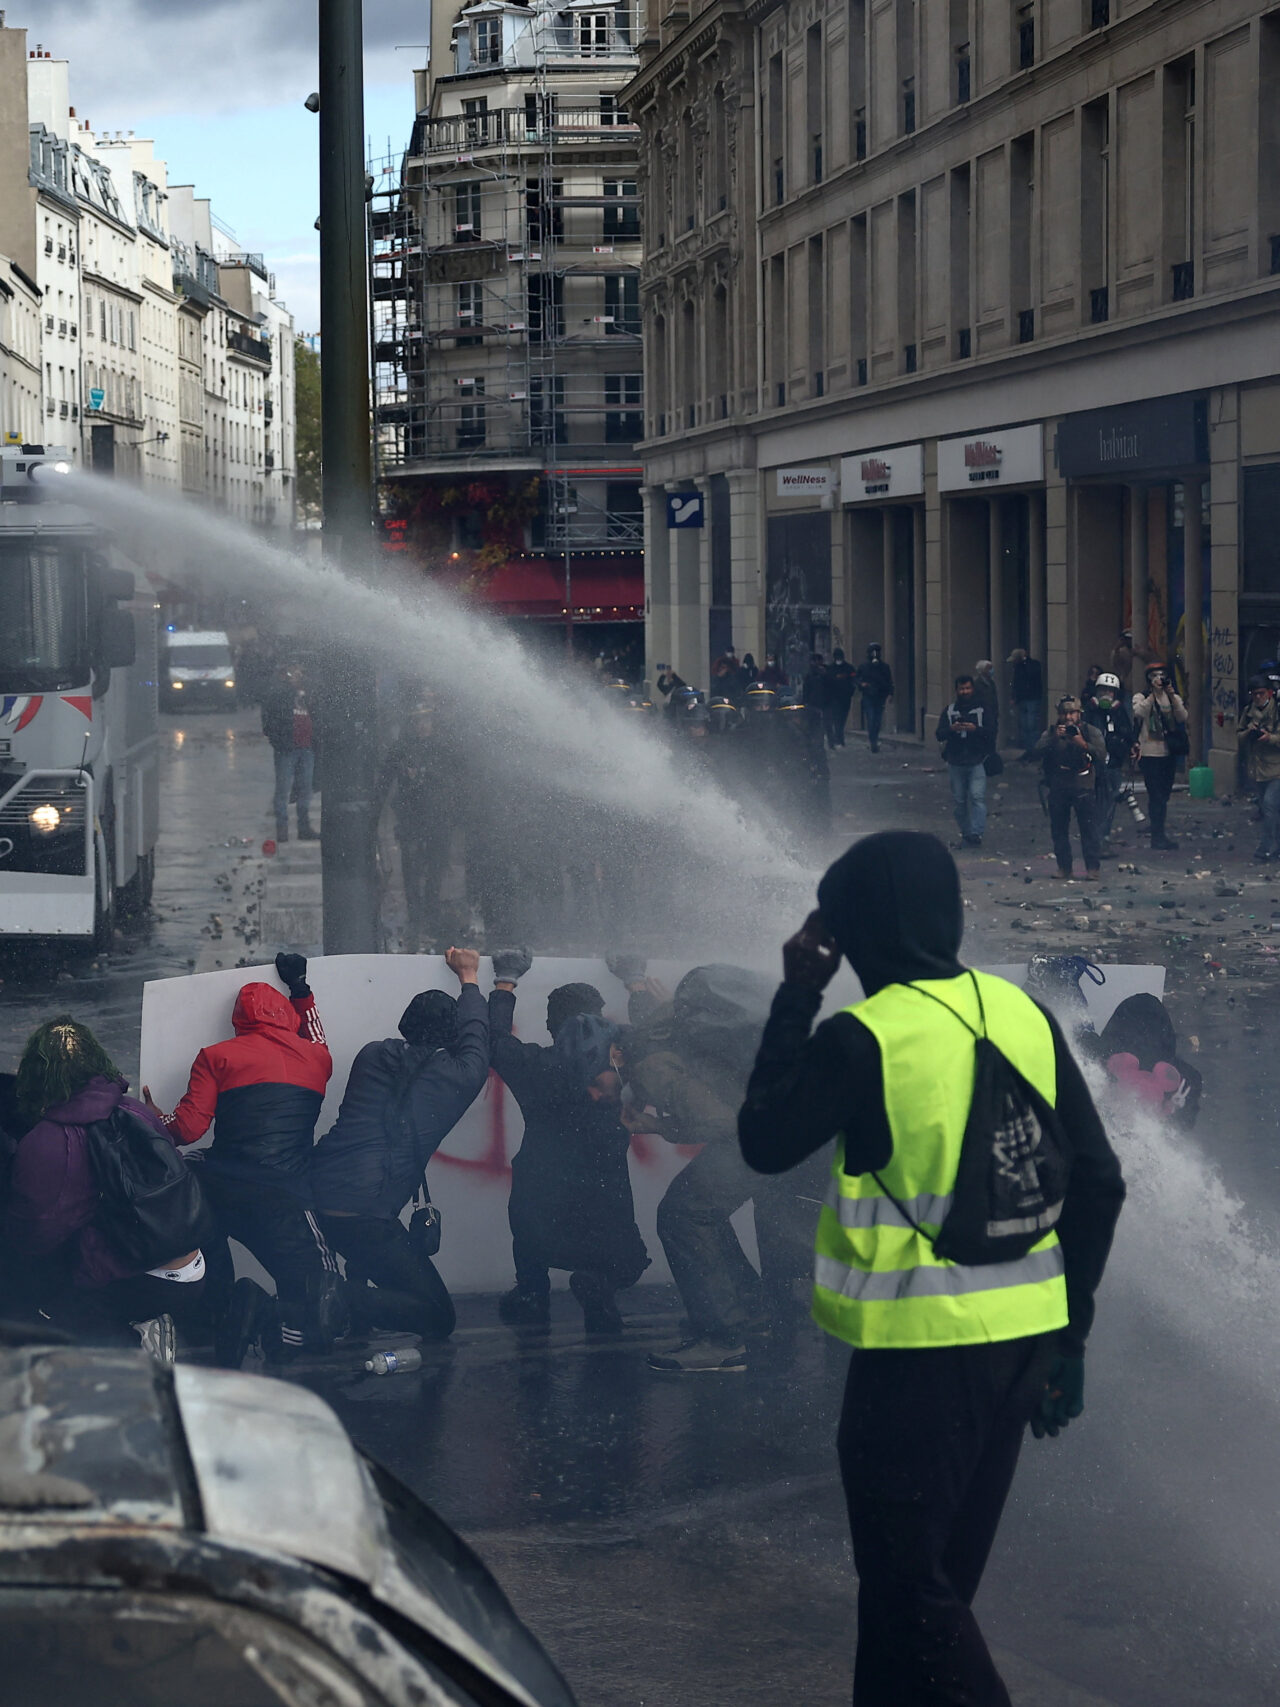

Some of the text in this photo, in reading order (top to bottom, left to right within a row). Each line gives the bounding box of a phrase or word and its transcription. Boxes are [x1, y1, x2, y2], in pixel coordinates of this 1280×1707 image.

[424, 118, 489, 148] HOTEL
[1099, 427, 1138, 460] habitat
[782, 475, 827, 485] WellNess
